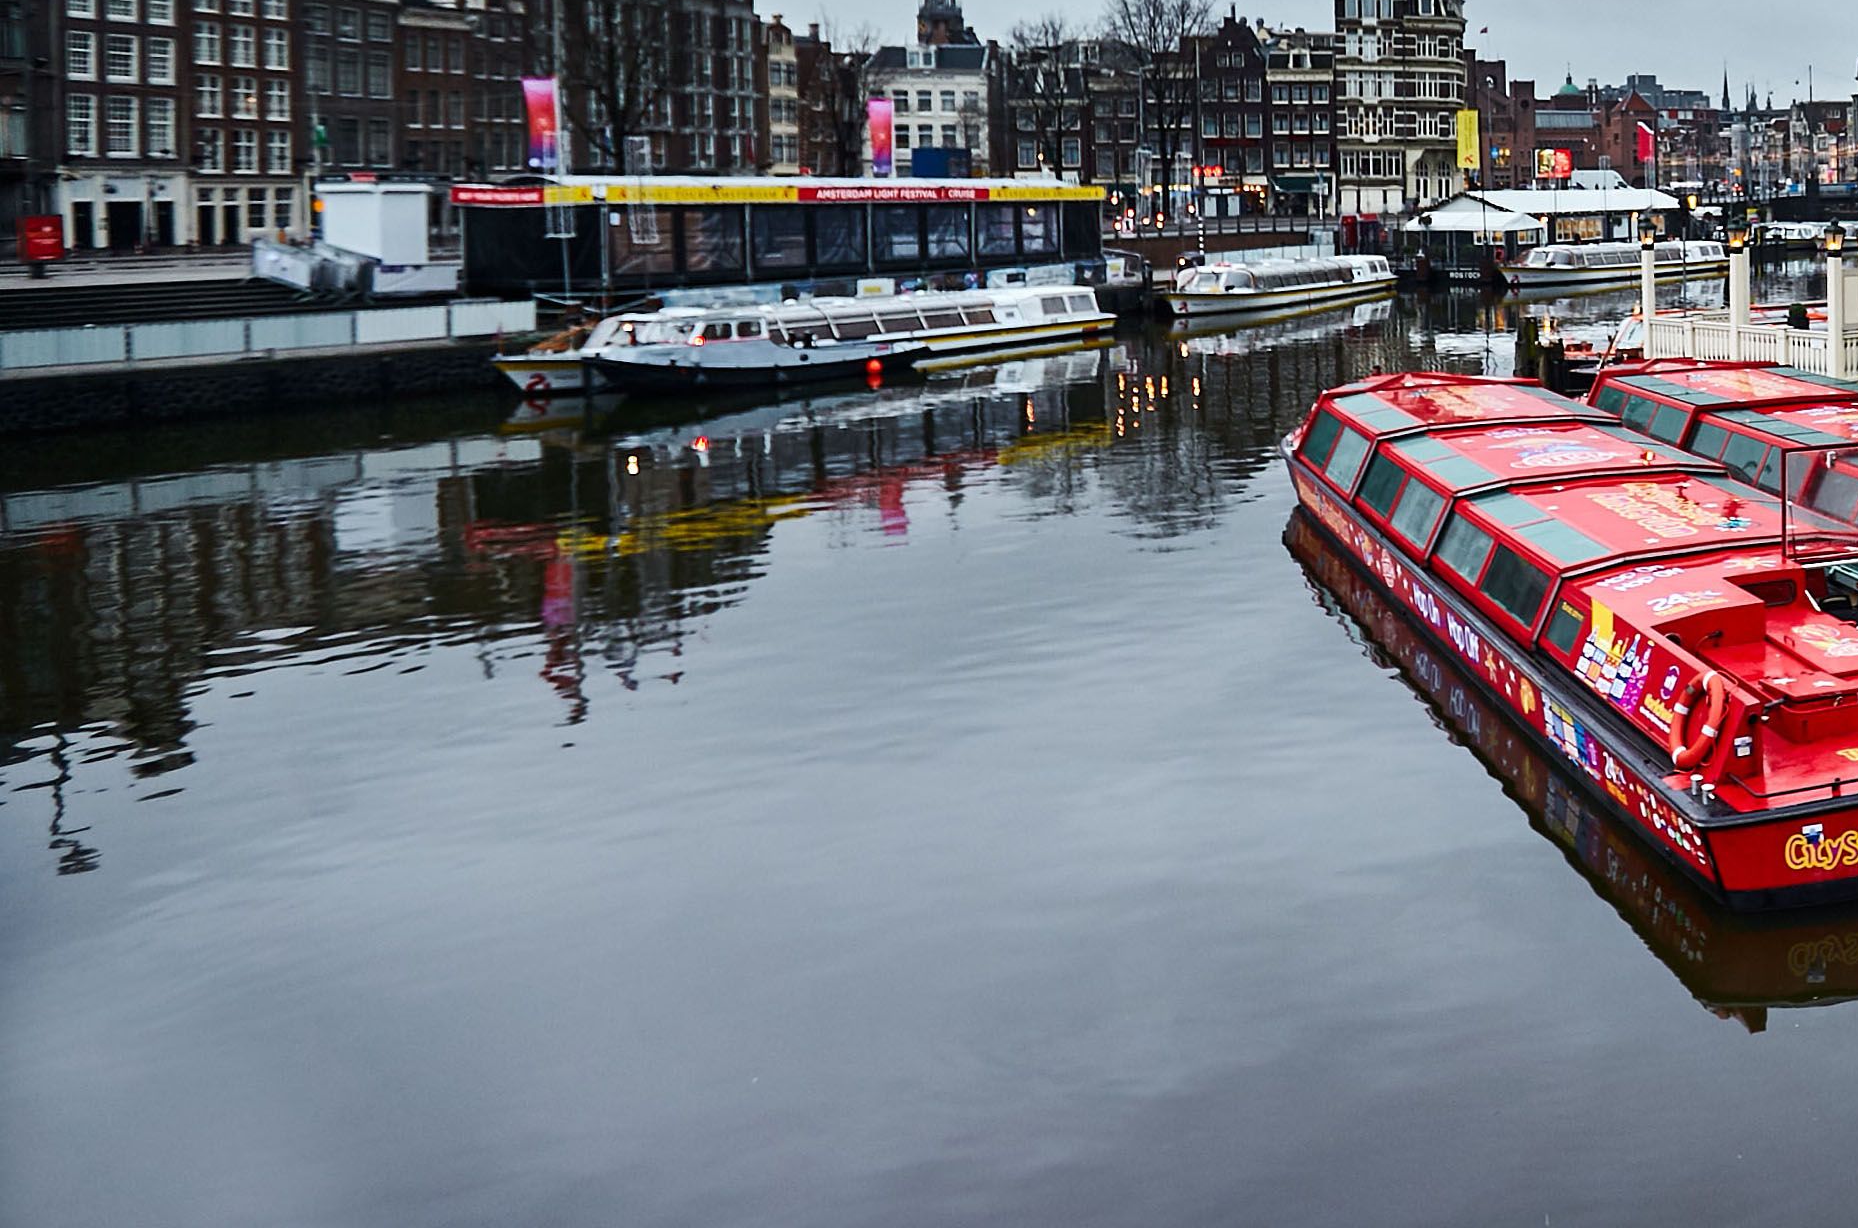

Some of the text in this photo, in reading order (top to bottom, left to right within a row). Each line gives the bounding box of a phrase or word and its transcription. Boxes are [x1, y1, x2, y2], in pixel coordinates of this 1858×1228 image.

[816, 188, 976, 200] AMSTERDAM LIGHT FESTIVAL CRUISE
